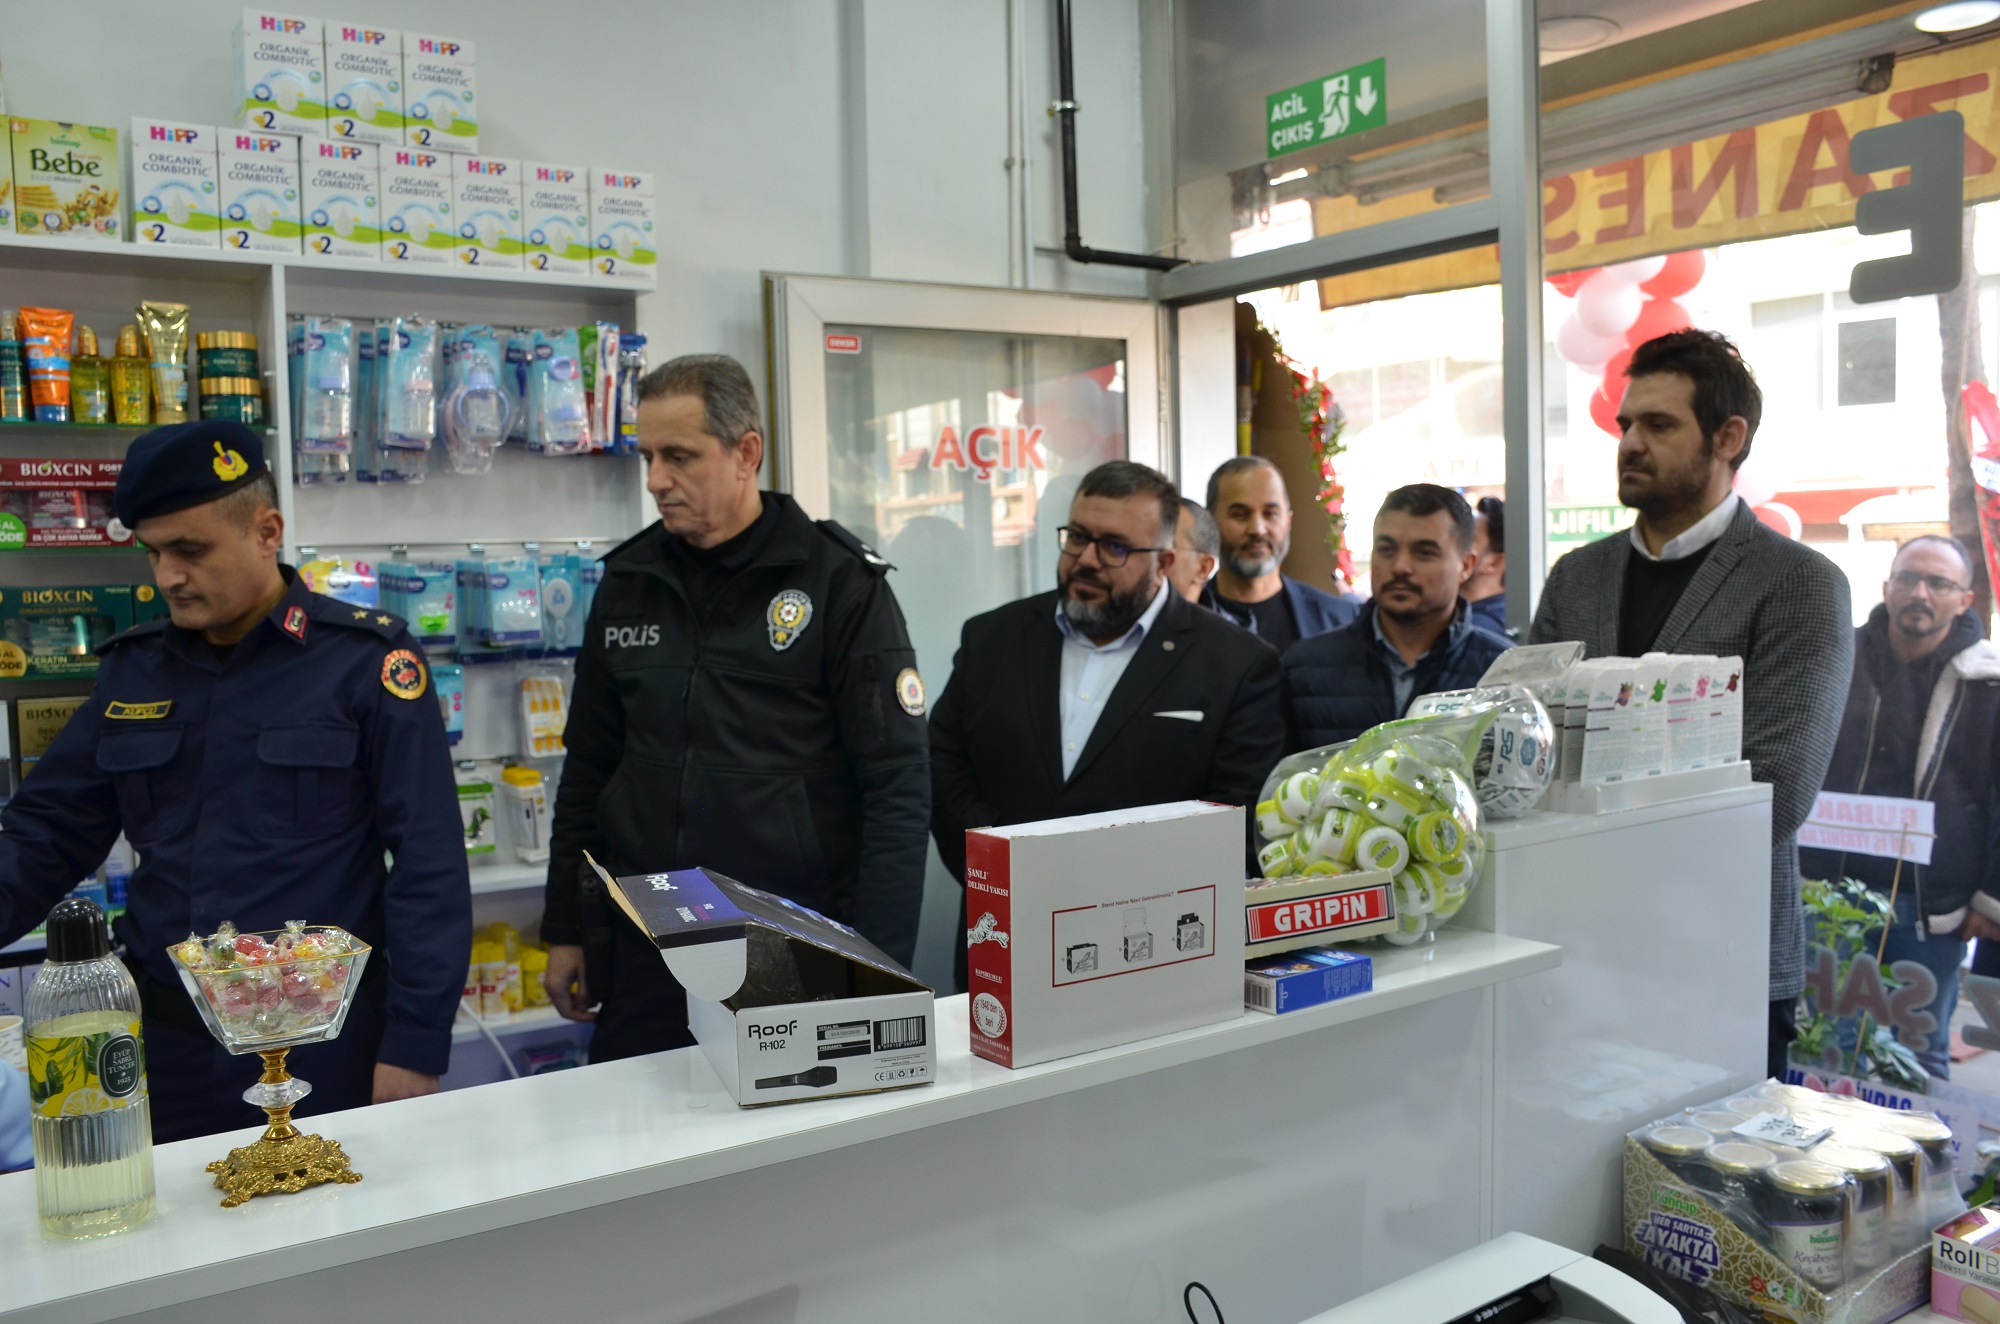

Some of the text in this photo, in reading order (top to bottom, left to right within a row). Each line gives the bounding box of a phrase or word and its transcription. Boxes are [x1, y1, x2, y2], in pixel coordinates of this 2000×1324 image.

[261, 16, 306, 34] HiPP
[342, 27, 385, 45] HiPP
[420, 39, 460, 56] HiPP
[253, 51, 317, 67] COMBIOTIC
[334, 62, 396, 77] COMBIOTIC
[412, 73, 471, 88] COMBIOTIC
[1270, 93, 1307, 122] ACİL
[263, 111, 276, 129] 2
[150, 126, 198, 143] HiPP
[343, 120, 355, 138] 2
[1271, 121, 1314, 150] ÇIKIŞ
[236, 135, 281, 152] HiPP
[419, 129, 431, 147] 2
[319, 144, 362, 160] HiPP
[397, 152, 436, 168] HiPP
[30, 149, 102, 177] Bebe
[142, 162, 210, 177] COMBIOTIC
[468, 160, 506, 175] HiPP
[228, 170, 292, 186] COMBIOTIC
[537, 168, 574, 183] HiPP
[605, 174, 641, 189] HiPP
[311, 178, 372, 193] COMBIOTIC
[154, 224, 166, 243] 2
[237, 231, 250, 249] 2
[320, 237, 332, 254] 2
[397, 243, 409, 259] 2
[468, 249, 479, 265] 2
[537, 254, 549, 271] 2
[604, 259, 615, 275] 2
[931, 426, 1045, 480] AÇIK
[20, 461, 92, 476] BIOXCIN
[22, 589, 93, 604] BIOXCIN
[968, 868, 987, 880] ŞANLI
[968, 880, 989, 893] DELİKLİ
[759, 1039, 786, 1051] R-102
[107, 1061, 135, 1074] TUNCER
[1643, 1225, 1714, 1262] AYAKTA
[1940, 1241, 1980, 1269] Roll
[1939, 1260, 1967, 1276] Tekstil
